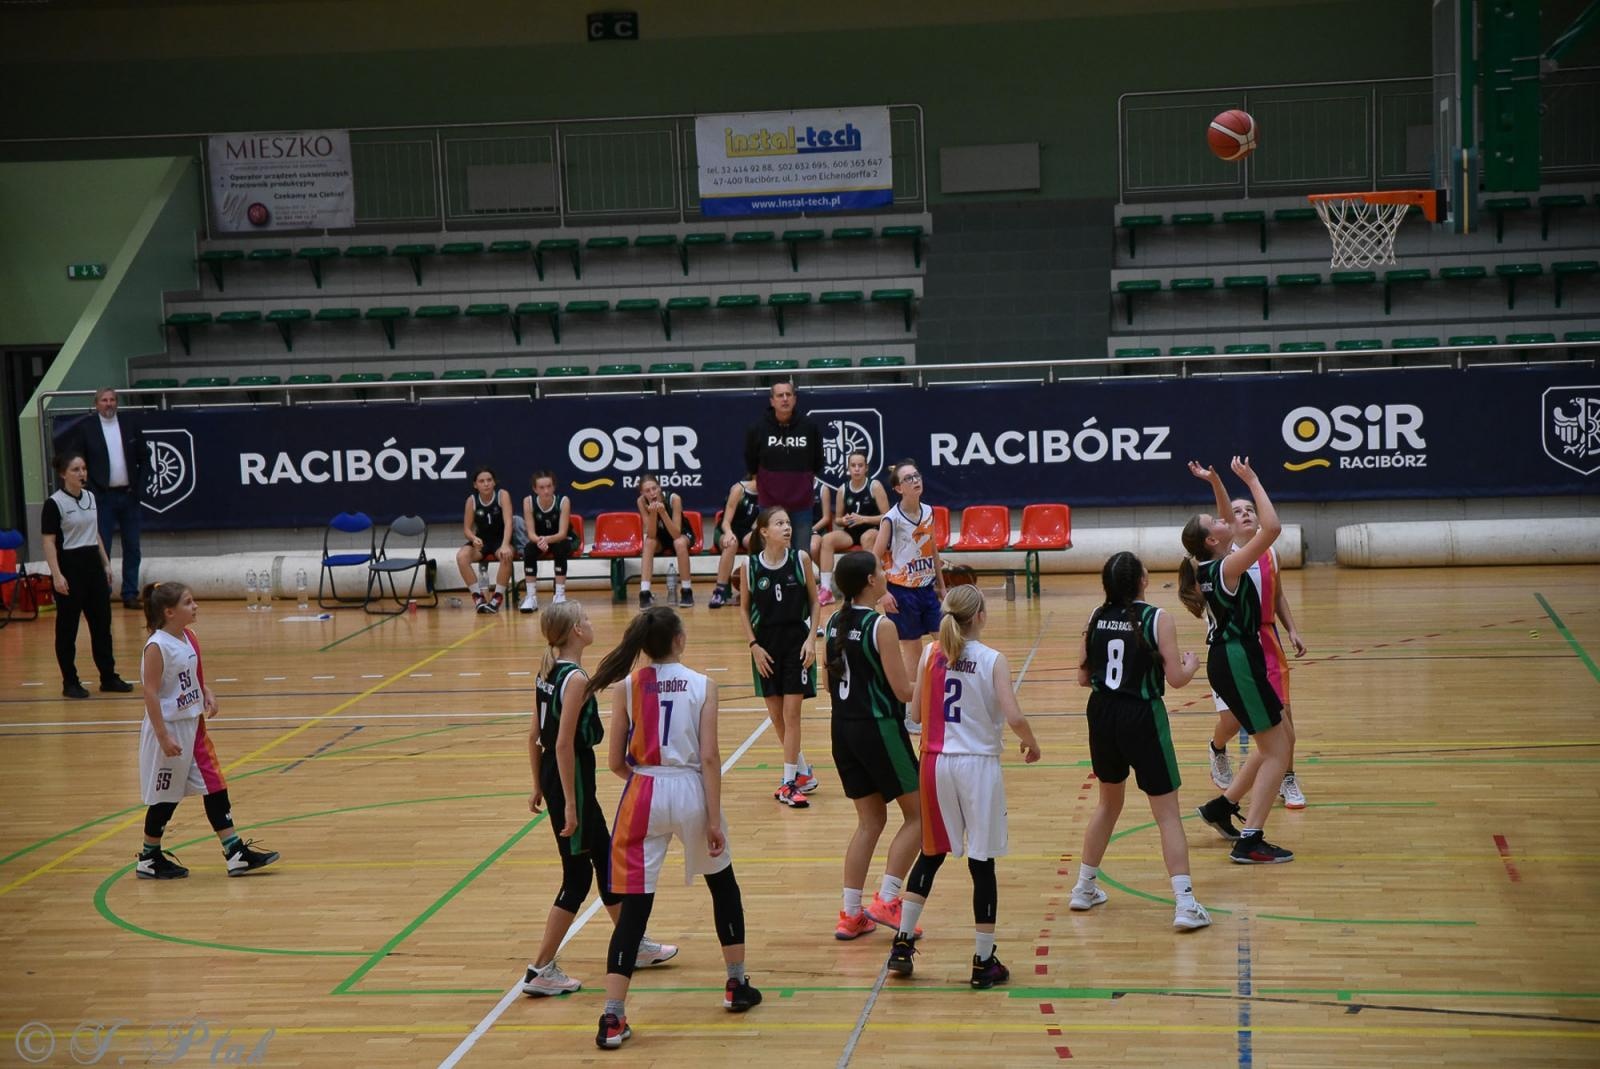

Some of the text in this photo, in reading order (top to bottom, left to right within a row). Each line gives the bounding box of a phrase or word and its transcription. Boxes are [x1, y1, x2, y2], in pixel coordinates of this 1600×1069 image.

[614, 20, 632, 37] C
[226, 136, 333, 160] MIESZKO
[725, 123, 862, 157] instal-tech
[230, 173, 262, 181] Operator
[270, 180, 315, 188] produkcyjny
[819, 170, 871, 180] Eichendorffa
[872, 170, 878, 178] 2
[273, 192, 306, 200] Czekamy
[752, 195, 841, 209] www.instal-tech.pl
[930, 416, 1172, 466] RACIBÓRZ
[239, 436, 467, 485] RACIBÓRZ
[1340, 451, 1427, 469] RACIBÓRZ
[775, 583, 782, 602] 6
[1105, 638, 1125, 690] 8
[801, 668, 808, 685] 6
[944, 678, 962, 723] 2
[660, 700, 674, 746] 7
[156, 772, 172, 791] 55
